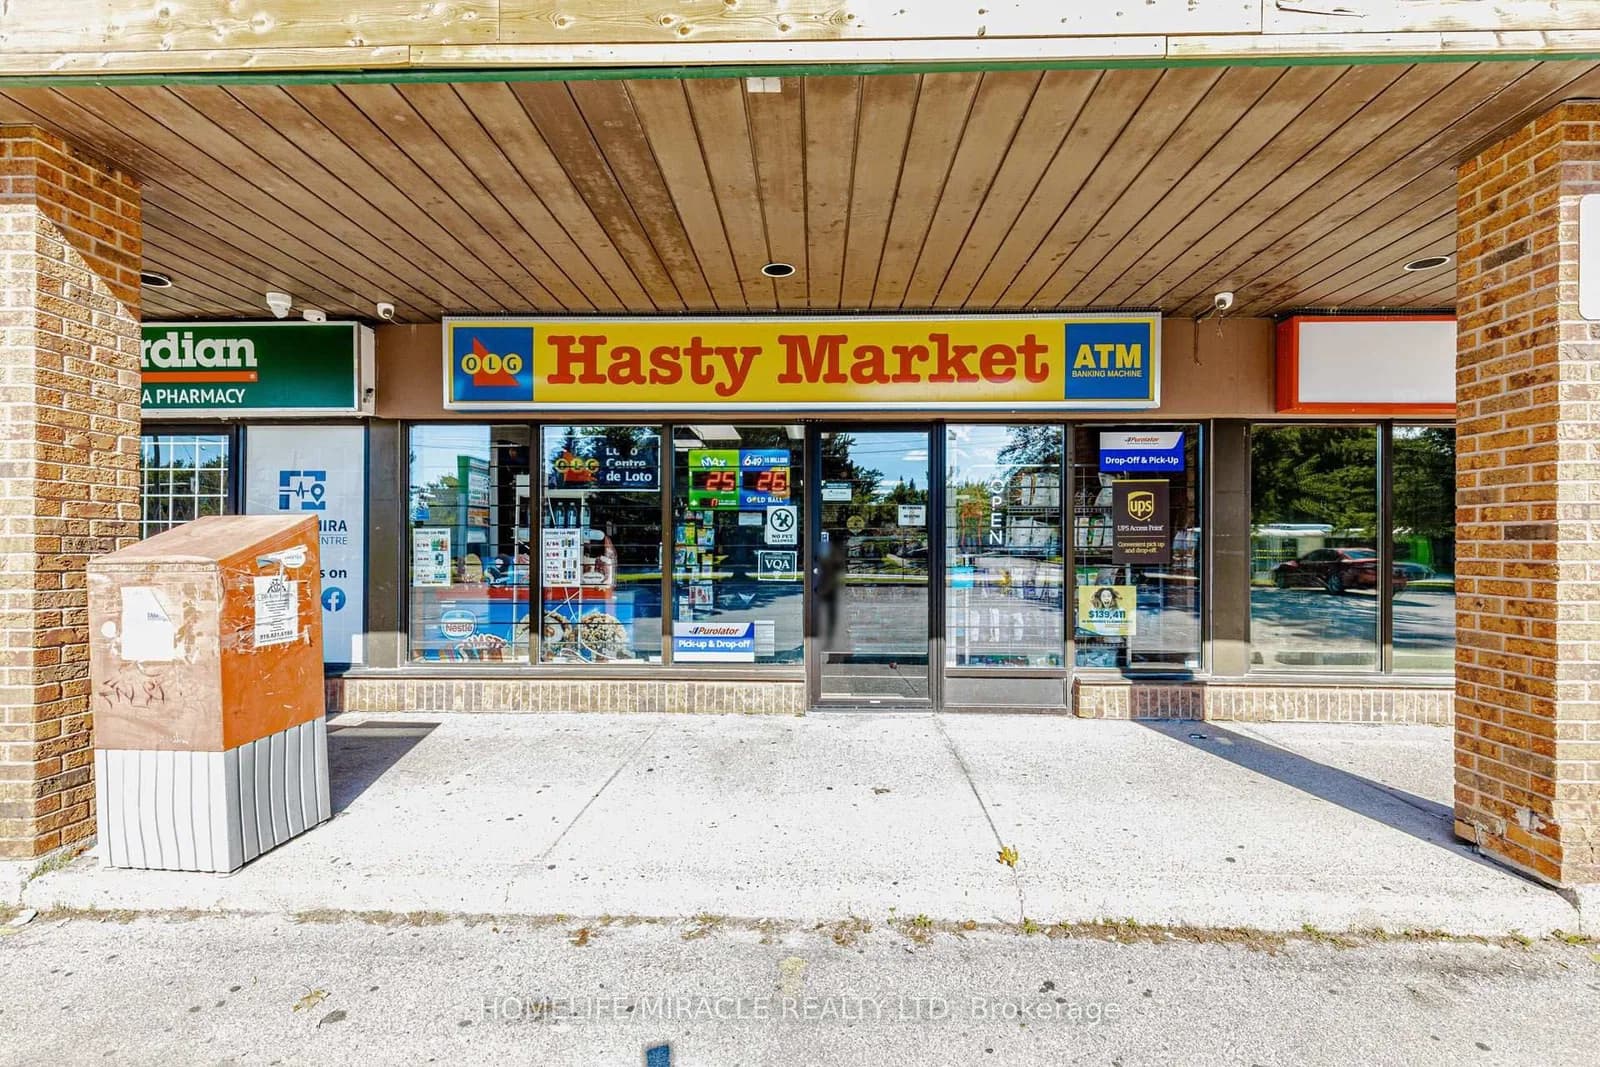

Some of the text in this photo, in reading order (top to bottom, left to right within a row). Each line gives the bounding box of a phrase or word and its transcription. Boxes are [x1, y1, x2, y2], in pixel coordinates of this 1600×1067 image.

[1073, 343, 1142, 369] ATM
[464, 355, 520, 372] OLG
[547, 332, 1050, 397] Hasty Market
[1071, 370, 1143, 378] BANKING MACHINE
[156, 388, 246, 404] PHARMACY
[606, 458, 646, 469] Centre
[1105, 456, 1179, 465] Drop-Off & Pick-Up
[606, 470, 652, 481] de Loto
[706, 472, 735, 491] 25
[757, 472, 786, 491] 26
[989, 479, 1005, 545] OPEN
[1130, 501, 1152, 516] ups
[318, 536, 347, 545] NTRE
[765, 559, 790, 570] VQA
[329, 569, 348, 578] on
[699, 626, 740, 635] Purolator
[678, 640, 751, 650] Pick-up & Drop-off
